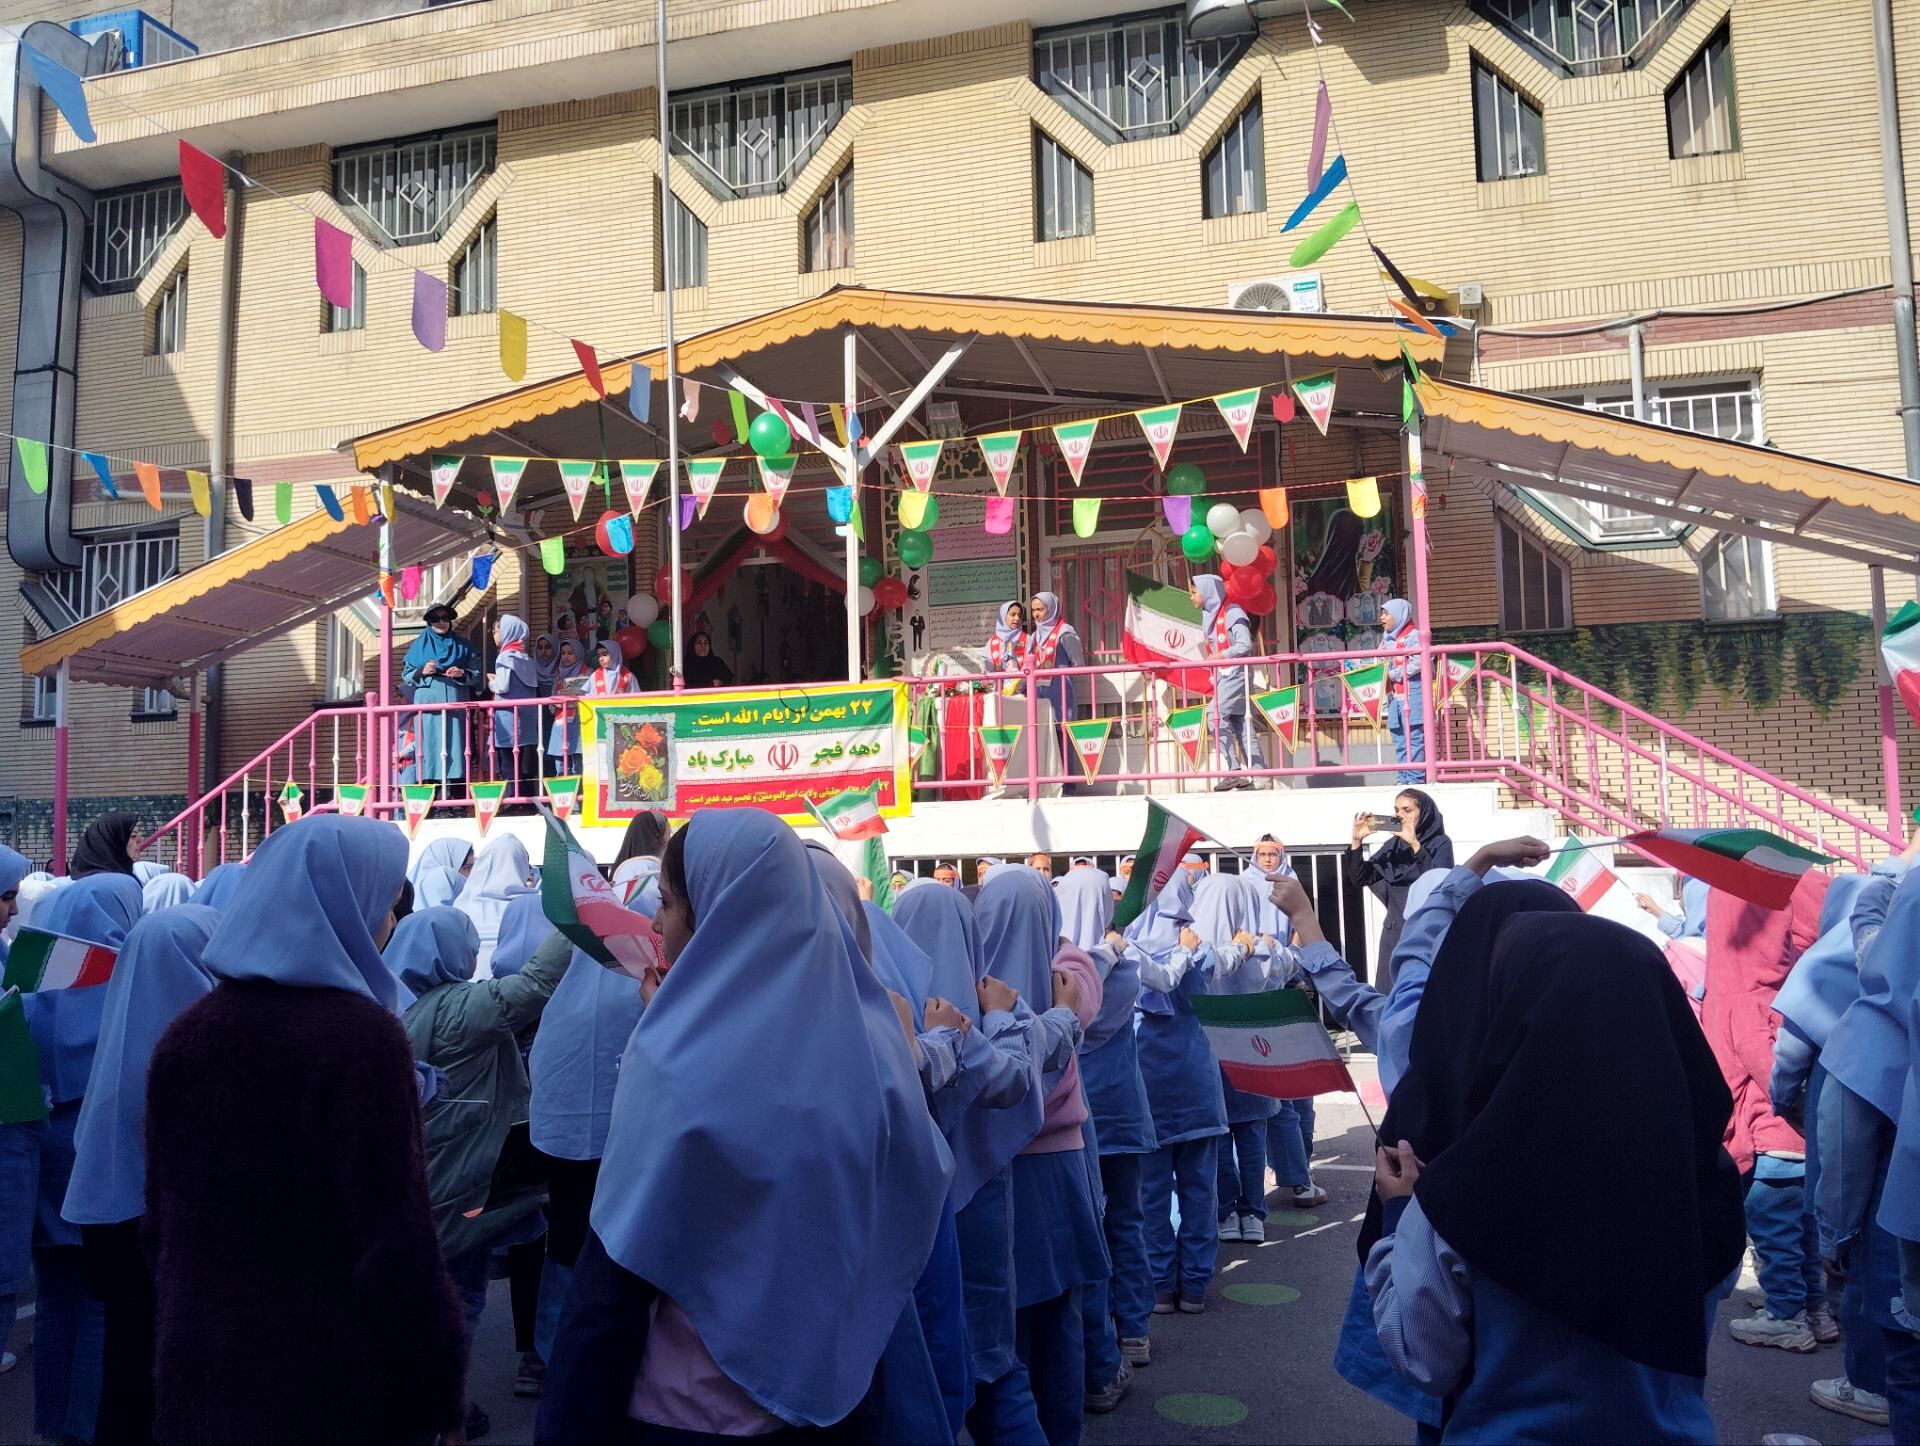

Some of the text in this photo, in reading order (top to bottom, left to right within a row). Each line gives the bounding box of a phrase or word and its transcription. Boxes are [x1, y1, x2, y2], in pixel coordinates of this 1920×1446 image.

[732, 706, 759, 724] الله
[762, 707, 790, 726] ایام
[791, 705, 806, 724] از
[810, 705, 847, 722] بهمن
[849, 699, 873, 716] ۲۲
[688, 740, 881, 772] دهه فجر مبارک باد
